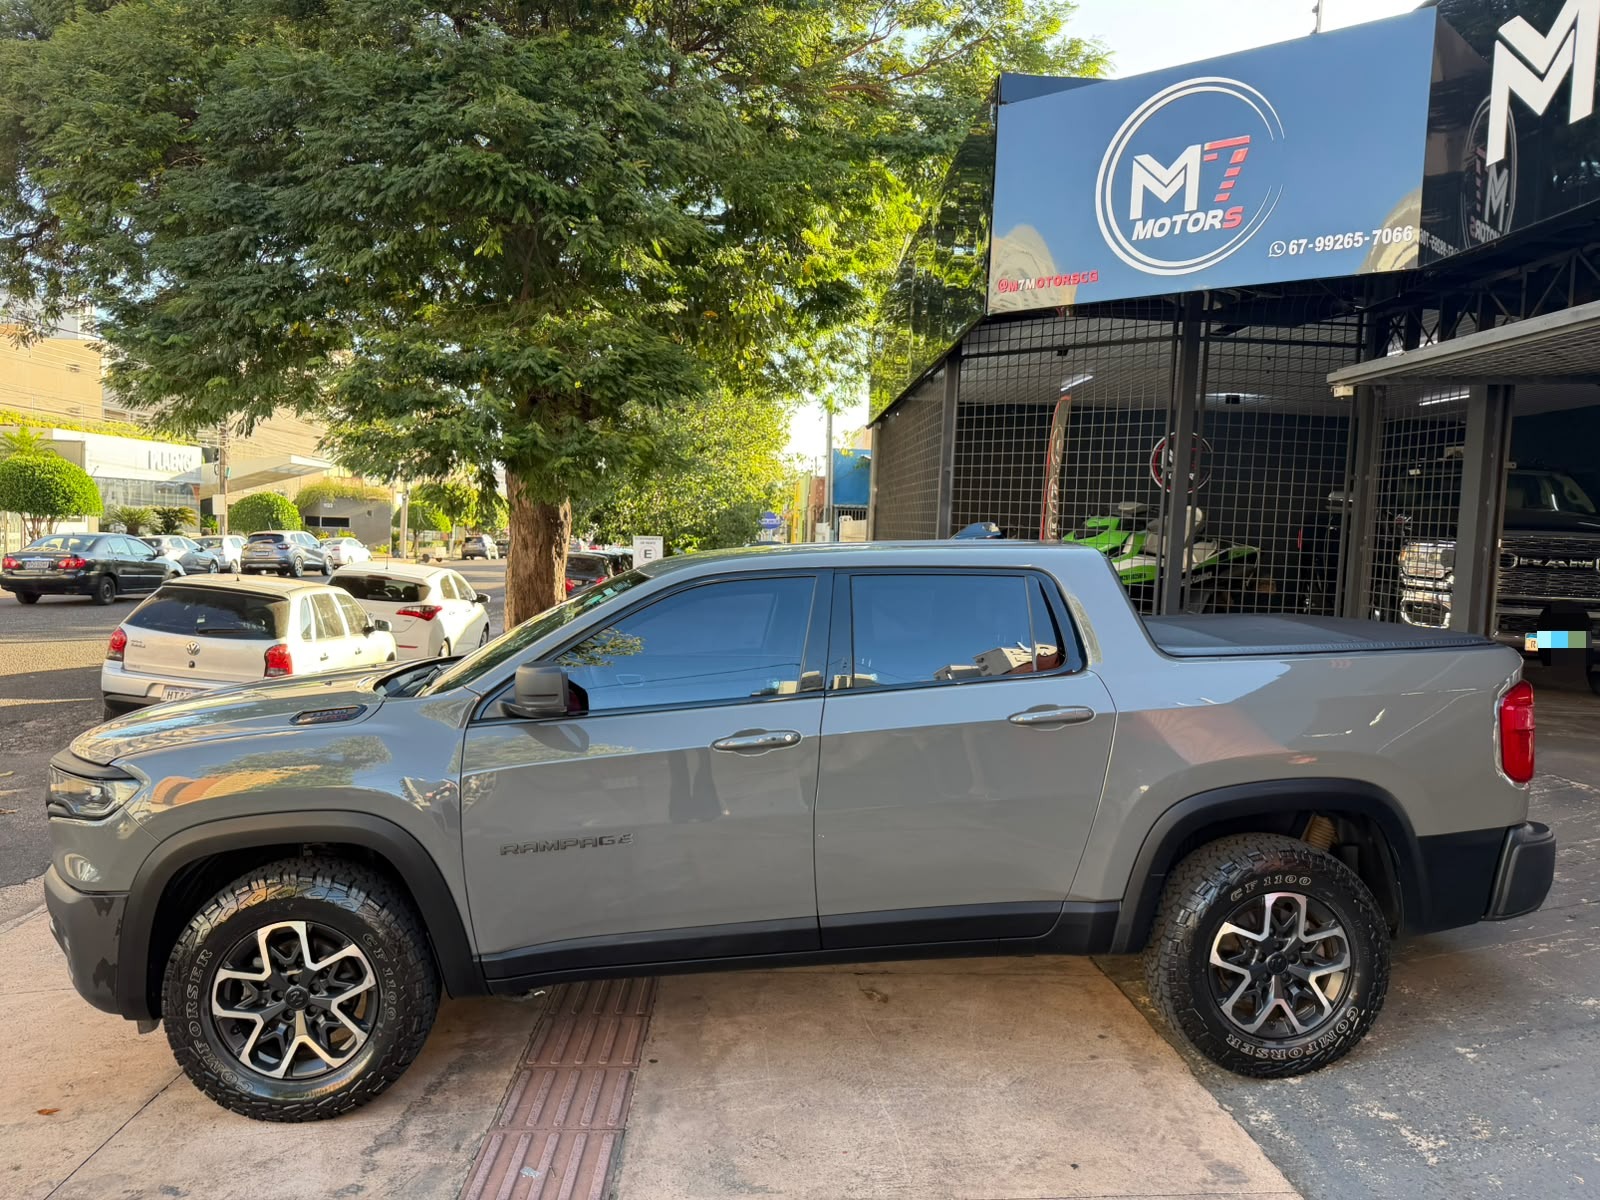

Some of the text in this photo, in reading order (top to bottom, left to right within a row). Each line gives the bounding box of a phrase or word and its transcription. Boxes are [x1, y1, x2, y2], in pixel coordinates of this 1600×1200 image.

[1130, 135, 1250, 220] M7
[1132, 206, 1244, 241] MOTORS
[1288, 225, 1414, 255] 67-99265-7066
[998, 269, 1099, 293] @M7MOTORSCG
[644, 549, 653, 559] E
[500, 832, 634, 856] RAMPAGE
[1263, 873, 1313, 887] 1100
